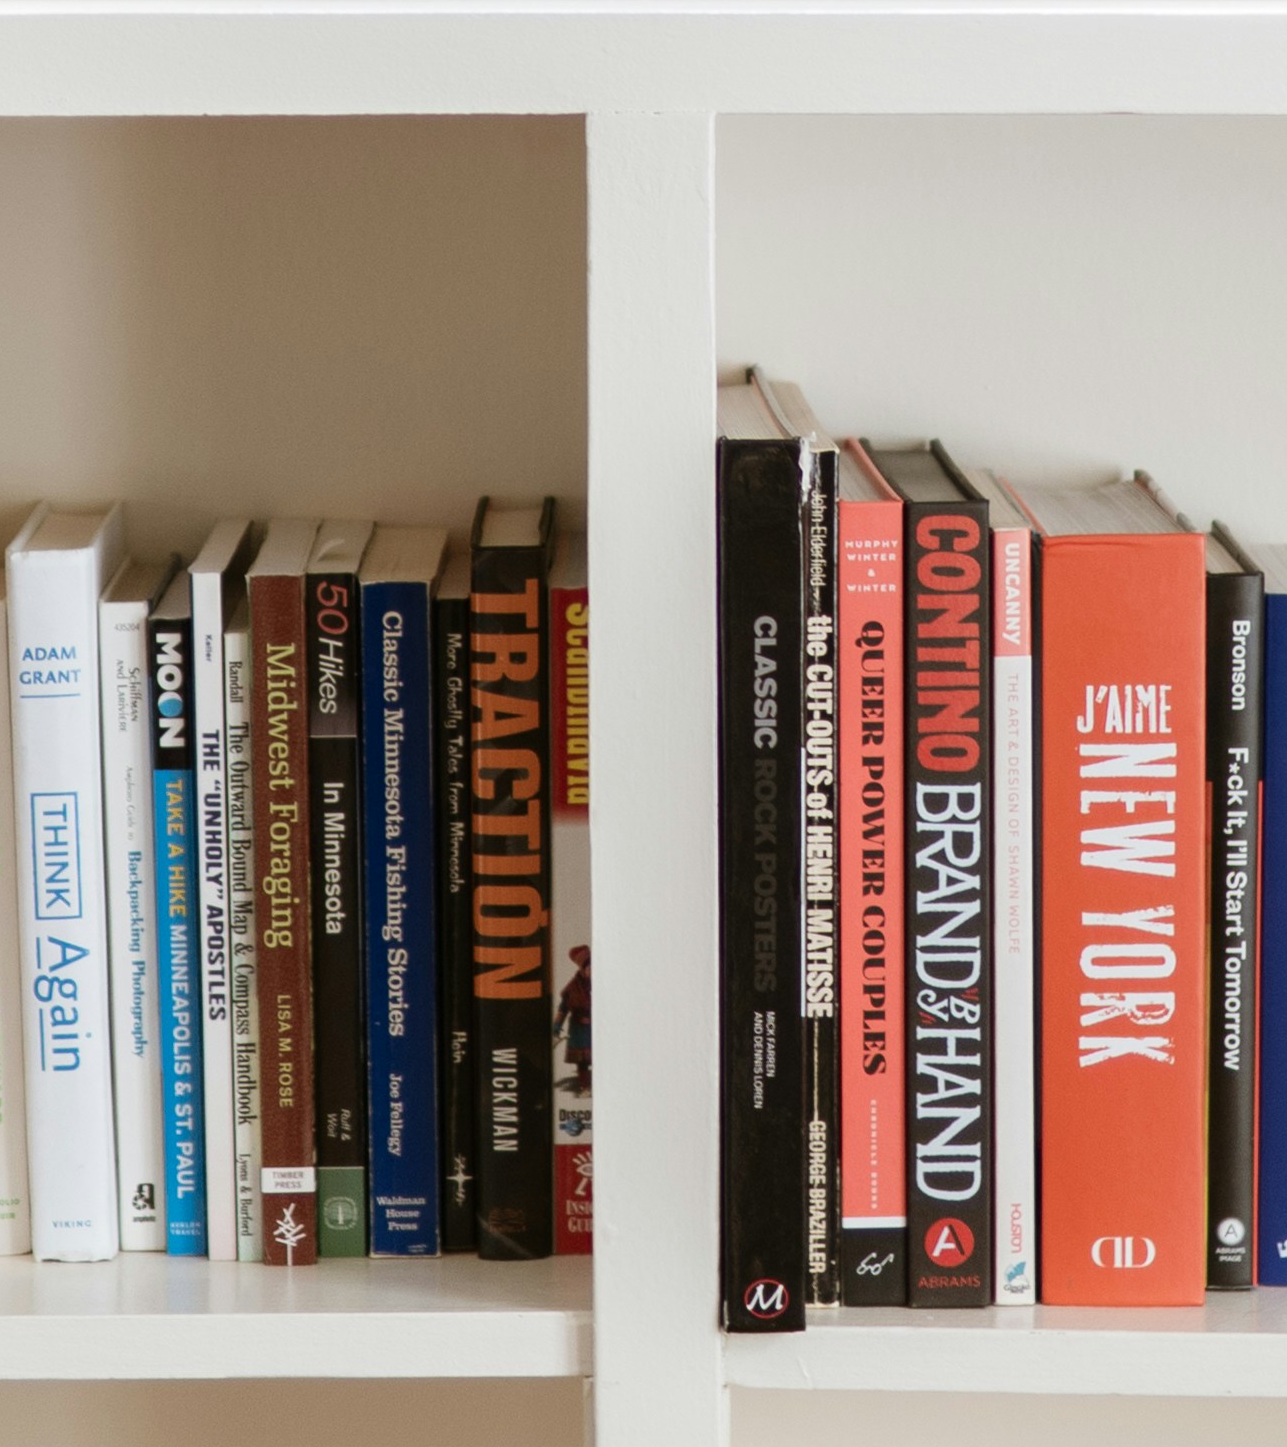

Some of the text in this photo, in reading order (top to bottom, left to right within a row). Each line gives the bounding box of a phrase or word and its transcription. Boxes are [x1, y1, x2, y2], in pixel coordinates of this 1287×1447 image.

[845, 540, 898, 548] MURPHY
[846, 553, 896, 561] WINTER
[846, 584, 896, 592] WINTER
[1003, 542, 1020, 646] UNCANNY
[19, 670, 81, 685] GRANT
[22, 647, 76, 661] ADAM
[155, 633, 185, 748] MOON
[317, 582, 349, 714] 50 Hikes
[915, 514, 981, 773] CONTINO
[1232, 619, 1251, 711] Bronson
[263, 643, 299, 948] Midwest Foraging
[381, 611, 409, 1037] Classic Minnesota Fishing Stories
[470, 578, 549, 1000] TRACTION
[753, 615, 778, 993] CLASSIC ROCK POSTERS
[43, 803, 71, 909] THINK
[165, 780, 187, 917] TAKE A HIKE
[323, 782, 346, 934] In Minnesota
[855, 621, 887, 1076] QUEER POWER COUPLES
[915, 782, 981, 988] BRAND
[128, 851, 147, 1057] Backpacking Photography
[229, 661, 258, 1237] Randall The Outward Bound Map & Compass Handbook Lyons & Burford
[1079, 743, 1176, 1067] NEW YORK
[34, 935, 91, 1073] Again
[277, 995, 293, 1107] LISA M. ROSE
[765, 1011, 775, 1078] MICK FARREN
[170, 925, 194, 1198] MINNEAPOLIS & ST. PAUL
[388, 1073, 404, 1157] Joe Fellegy
[492, 1048, 518, 1152] WICKMAN
[916, 1026, 982, 1201] HAND
[53, 1220, 92, 1228] VIKING
[273, 1171, 304, 1180] TIMBER
[275, 1181, 302, 1190] PRESS
[376, 1196, 426, 1206] Waldman
[385, 1209, 420, 1219] House
[388, 1222, 418, 1231] Press
[809, 1121, 825, 1274] GEORGE BRAZILLER
[918, 1277, 980, 1287] ABRAMS
